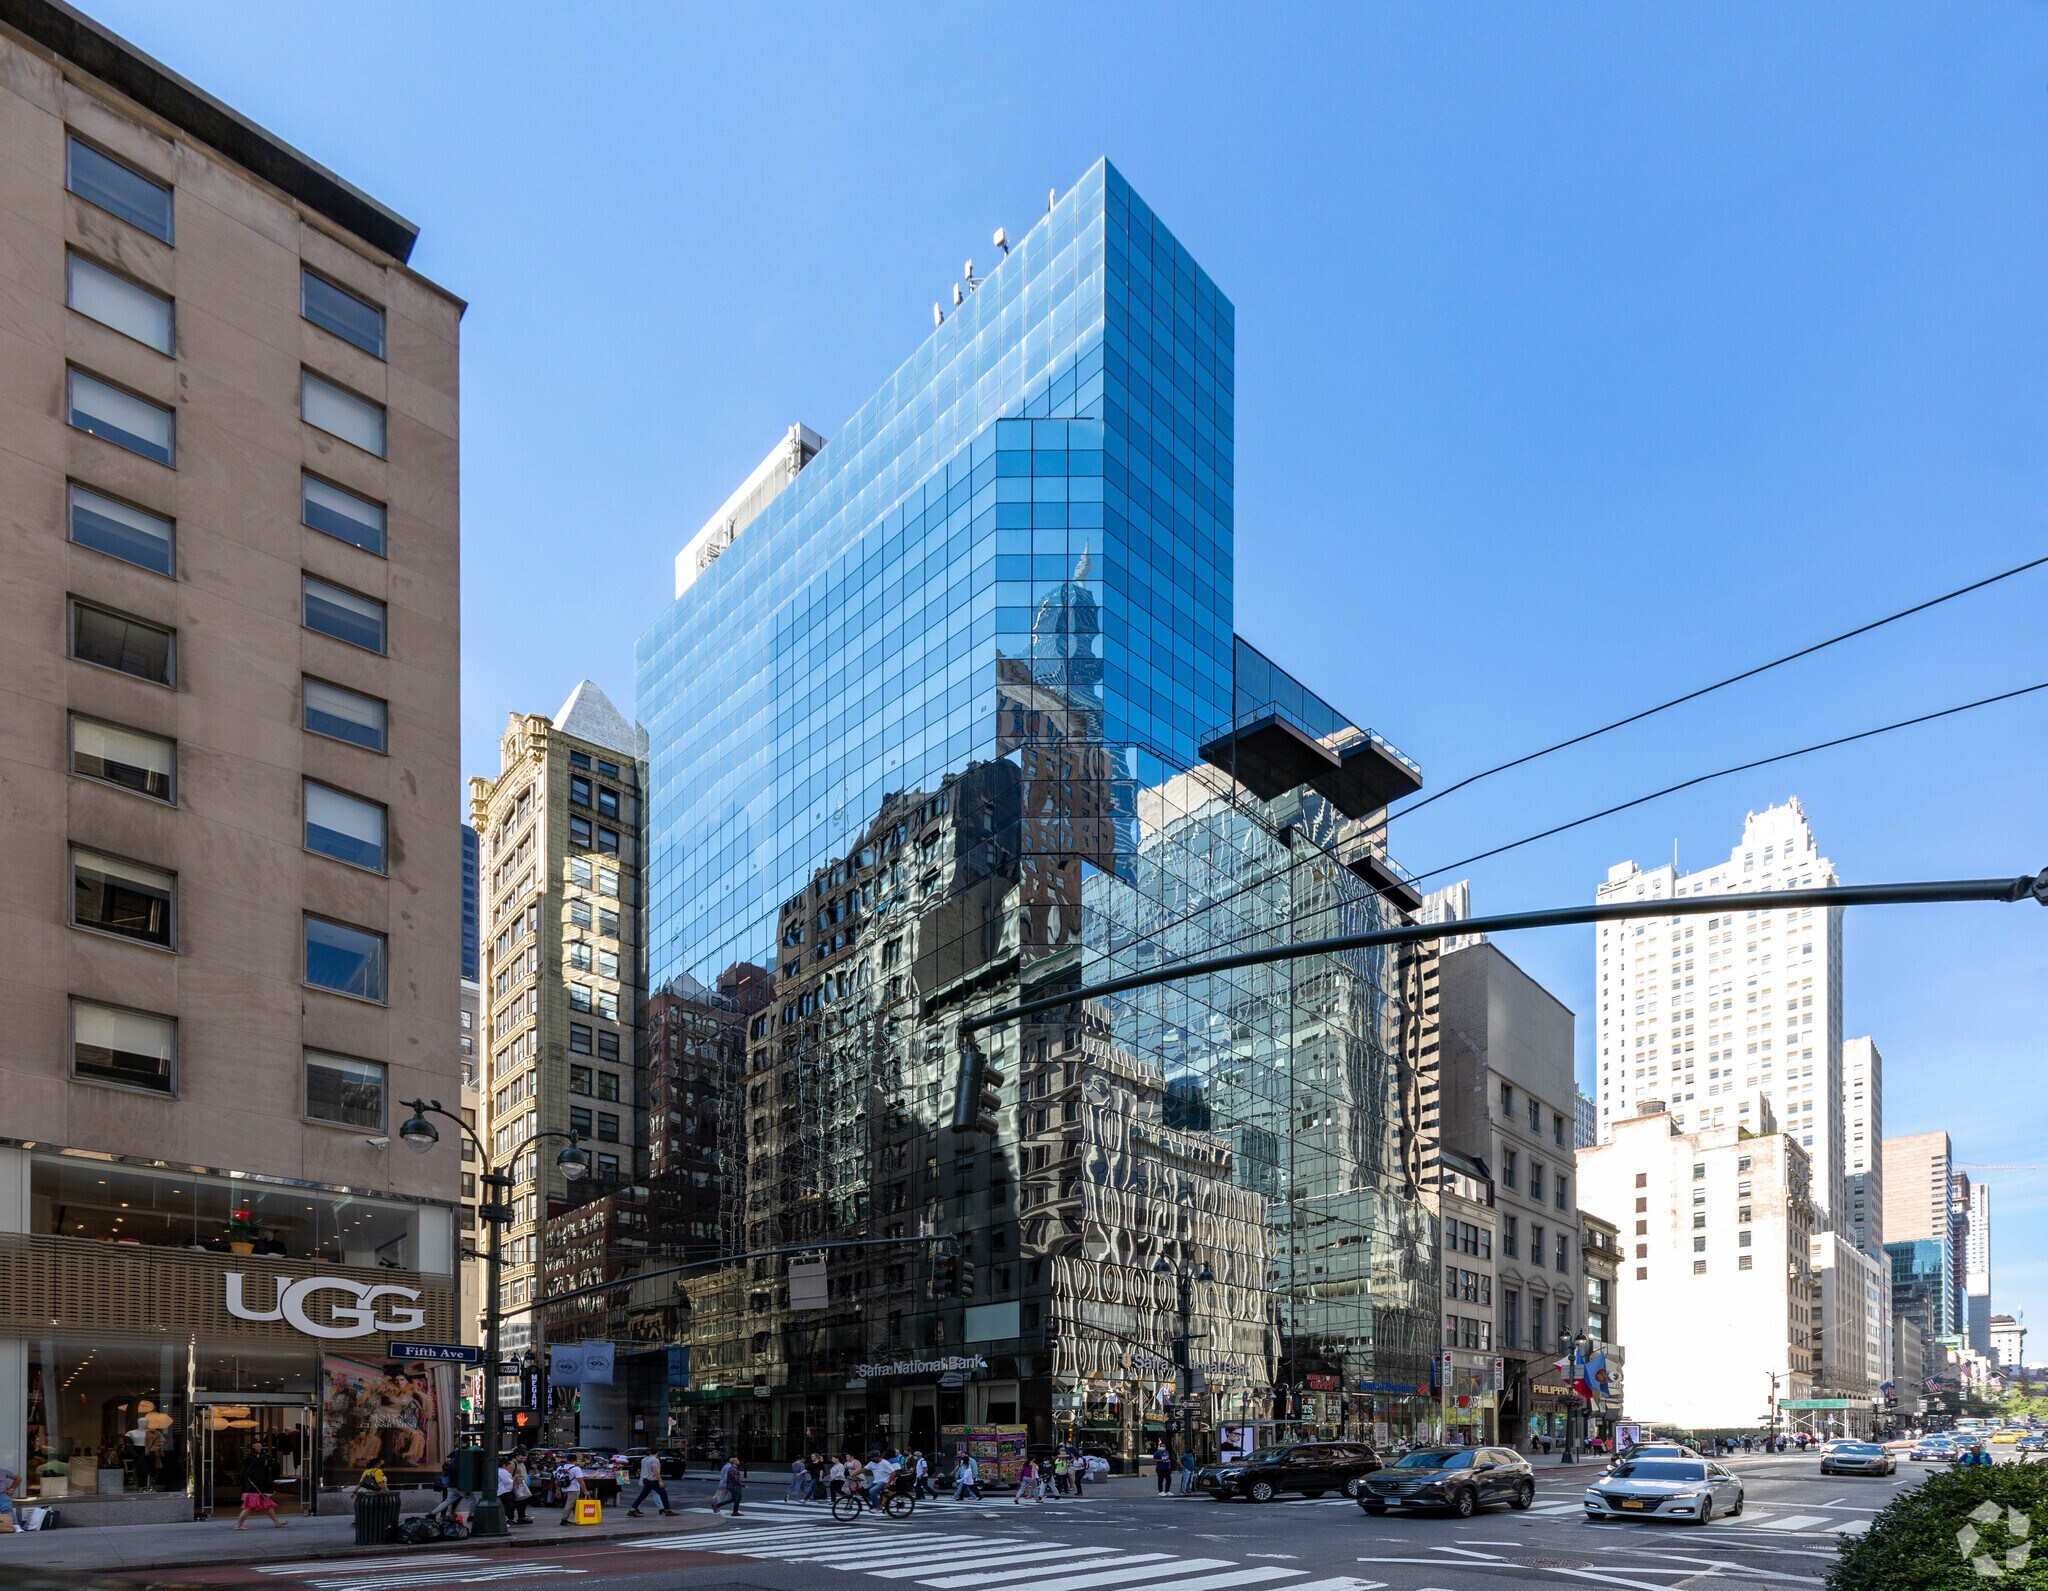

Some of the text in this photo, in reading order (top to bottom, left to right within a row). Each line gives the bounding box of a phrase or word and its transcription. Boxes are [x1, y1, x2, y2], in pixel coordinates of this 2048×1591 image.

[223, 1272, 426, 1339] UGG
[405, 1346, 464, 1358] Fifth Ave
[858, 1354, 984, 1377] Safra National Bank
[1134, 1354, 1169, 1370] Safra
[1223, 1361, 1250, 1376] Bank
[1533, 1384, 1578, 1396] PHILIPPINS
[1093, 1411, 1114, 1421] Safra
